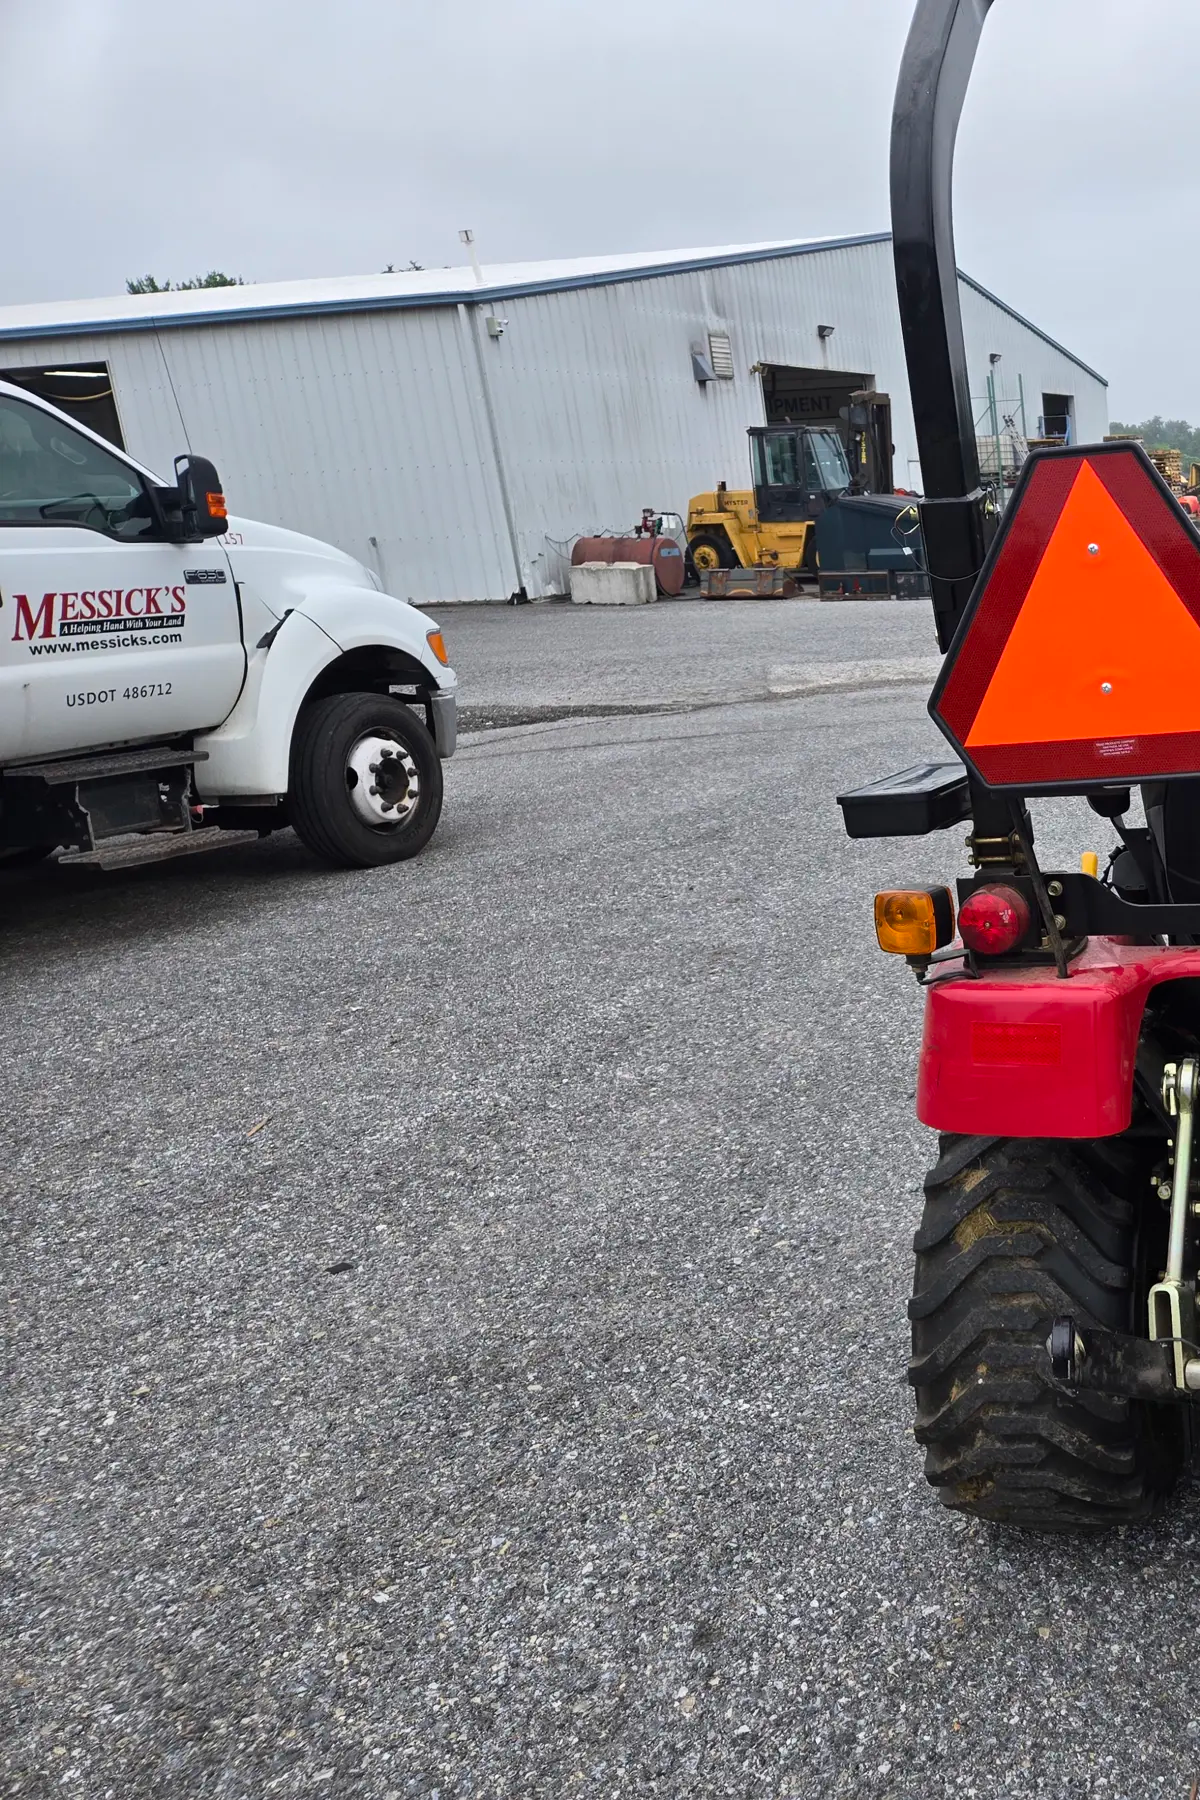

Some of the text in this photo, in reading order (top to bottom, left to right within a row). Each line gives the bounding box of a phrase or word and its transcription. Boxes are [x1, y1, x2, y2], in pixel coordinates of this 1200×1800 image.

[223, 532, 244, 545] 157
[11, 586, 186, 641] MESSICK'S
[61, 616, 182, 635] A Helping Hand With Your Land
[29, 632, 182, 656] www.messicks.com
[66, 682, 172, 707] USDOT 486712
